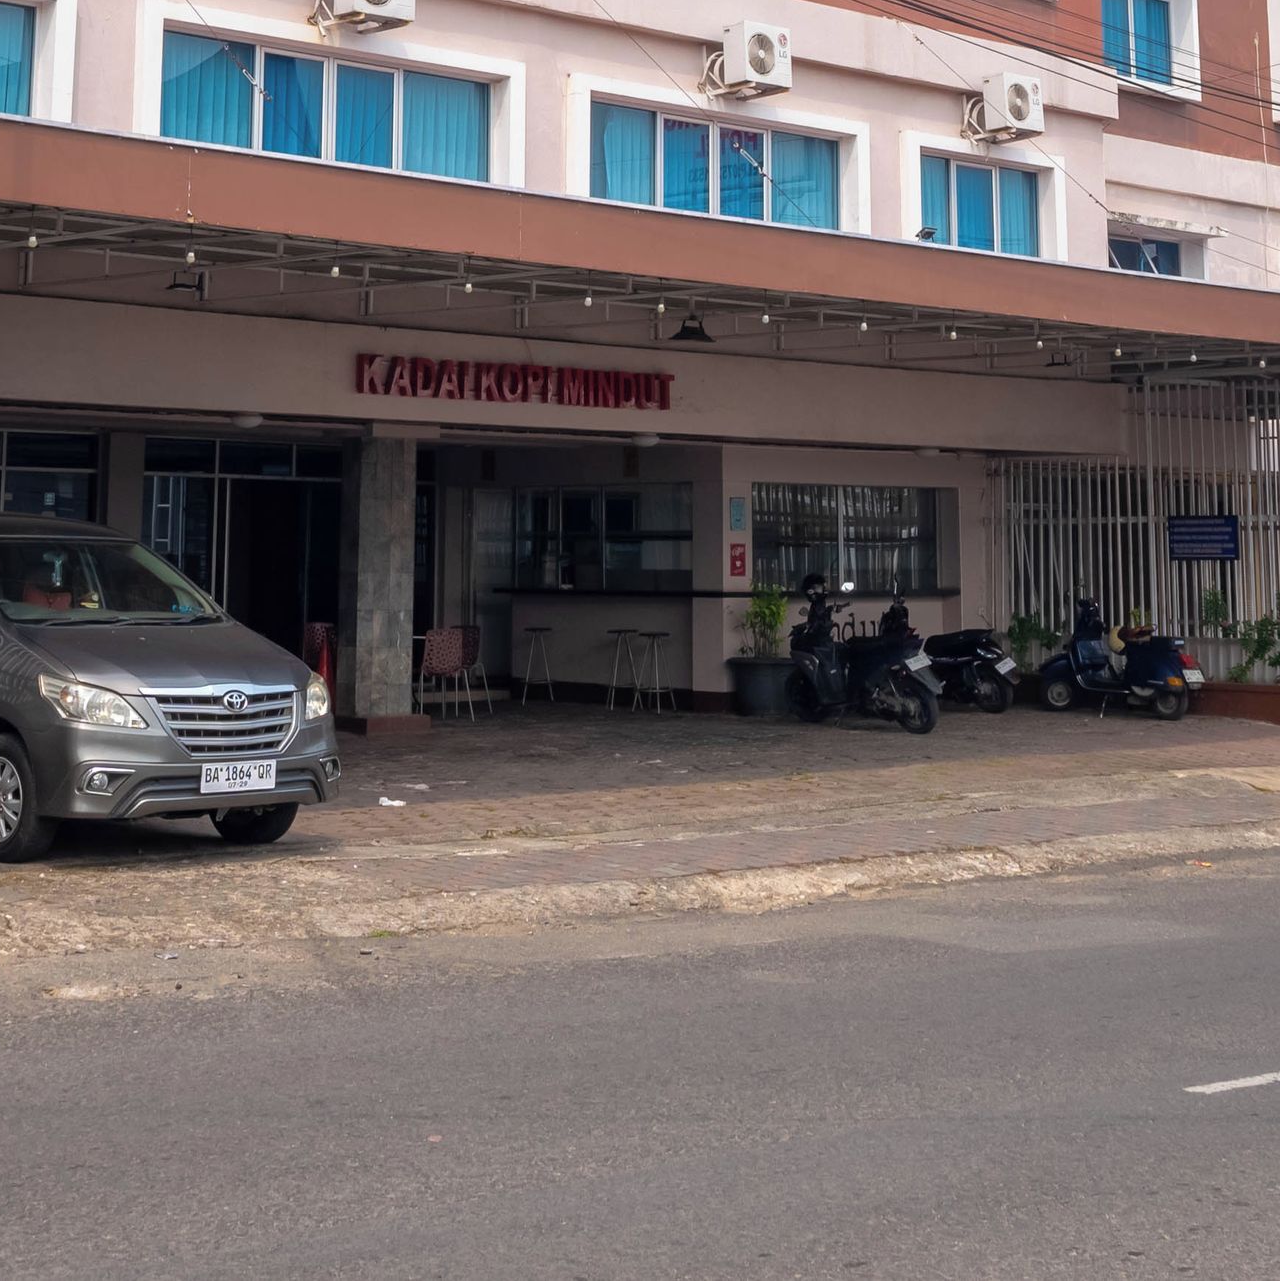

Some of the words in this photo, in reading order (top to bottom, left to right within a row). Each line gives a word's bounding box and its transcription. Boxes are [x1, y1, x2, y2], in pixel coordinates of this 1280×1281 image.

[778, 50, 788, 59] LG
[356, 353, 470, 399] KADAI
[473, 363, 553, 403] KOPI
[558, 367, 675, 411] MINDUT
[205, 767, 220, 783] BA
[225, 765, 252, 781] 1864
[258, 764, 272, 779] QR
